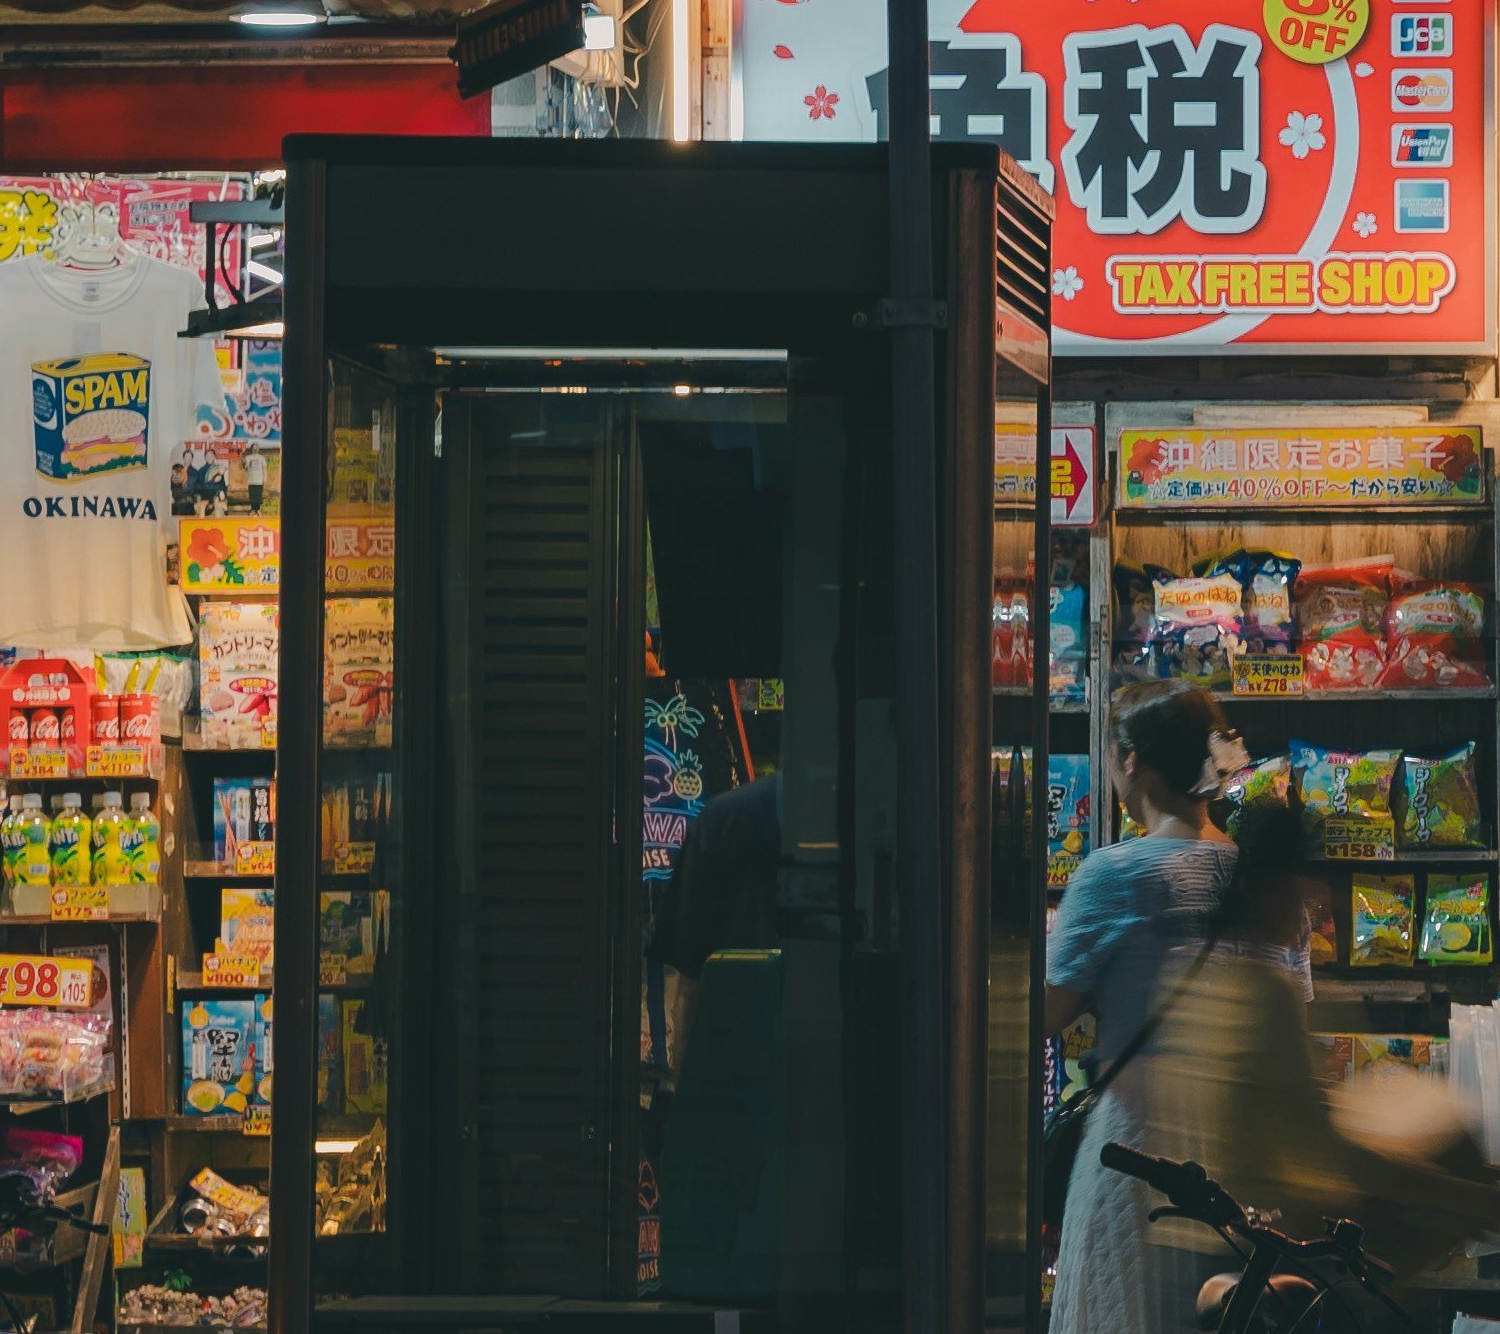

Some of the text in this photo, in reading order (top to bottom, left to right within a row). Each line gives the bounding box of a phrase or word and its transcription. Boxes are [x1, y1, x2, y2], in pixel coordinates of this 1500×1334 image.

[1278, 16, 1348, 55] OFF
[1395, 80, 1450, 100] MasterCard
[1115, 261, 1446, 305] TAX FREE SHOP
[65, 371, 148, 414] SPAM
[1152, 435, 1447, 473] 沖縄限定お菓子
[22, 494, 158, 521] OKINAWA
[1326, 826, 1393, 837] ポテトチップス
[1326, 842, 1377, 859] ¥158
